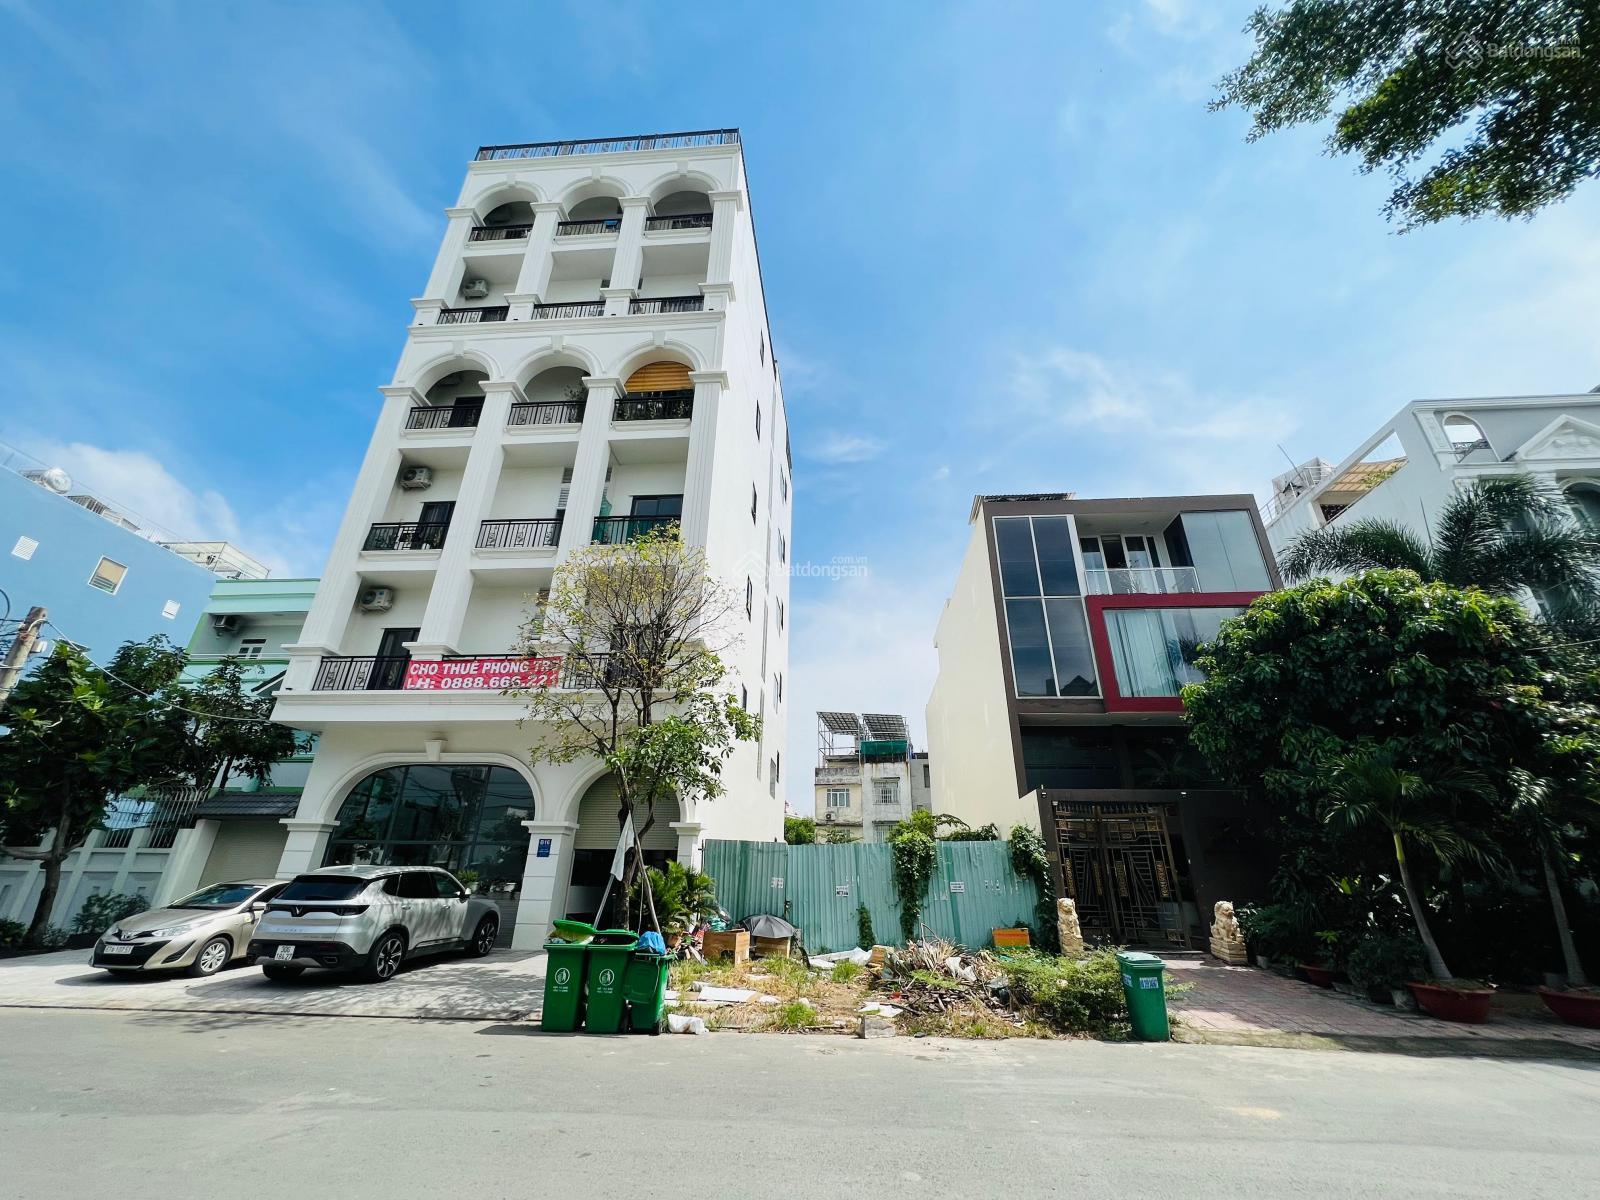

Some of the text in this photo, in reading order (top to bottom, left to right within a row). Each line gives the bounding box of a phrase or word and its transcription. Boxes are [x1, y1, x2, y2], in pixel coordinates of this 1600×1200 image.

[409, 663, 439, 675] CHO
[442, 660, 480, 675] THUÊ
[533, 659, 560, 673] TR
[406, 677, 435, 689] LH:
